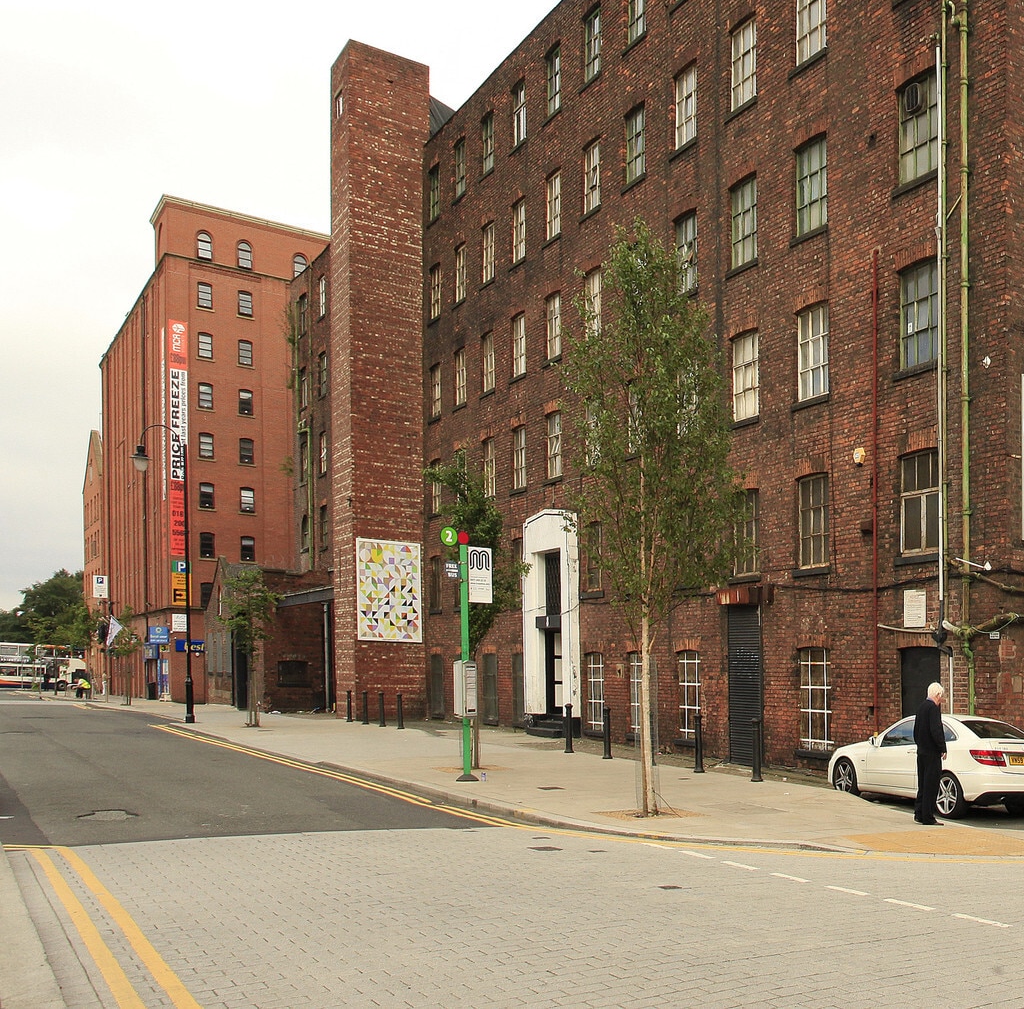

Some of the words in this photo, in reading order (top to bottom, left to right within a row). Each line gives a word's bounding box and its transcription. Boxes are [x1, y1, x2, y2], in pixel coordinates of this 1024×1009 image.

[171, 370, 180, 428] FREEZE
[171, 434, 180, 479] PRICE
[445, 530, 453, 543] 2
[178, 562, 186, 572] P
